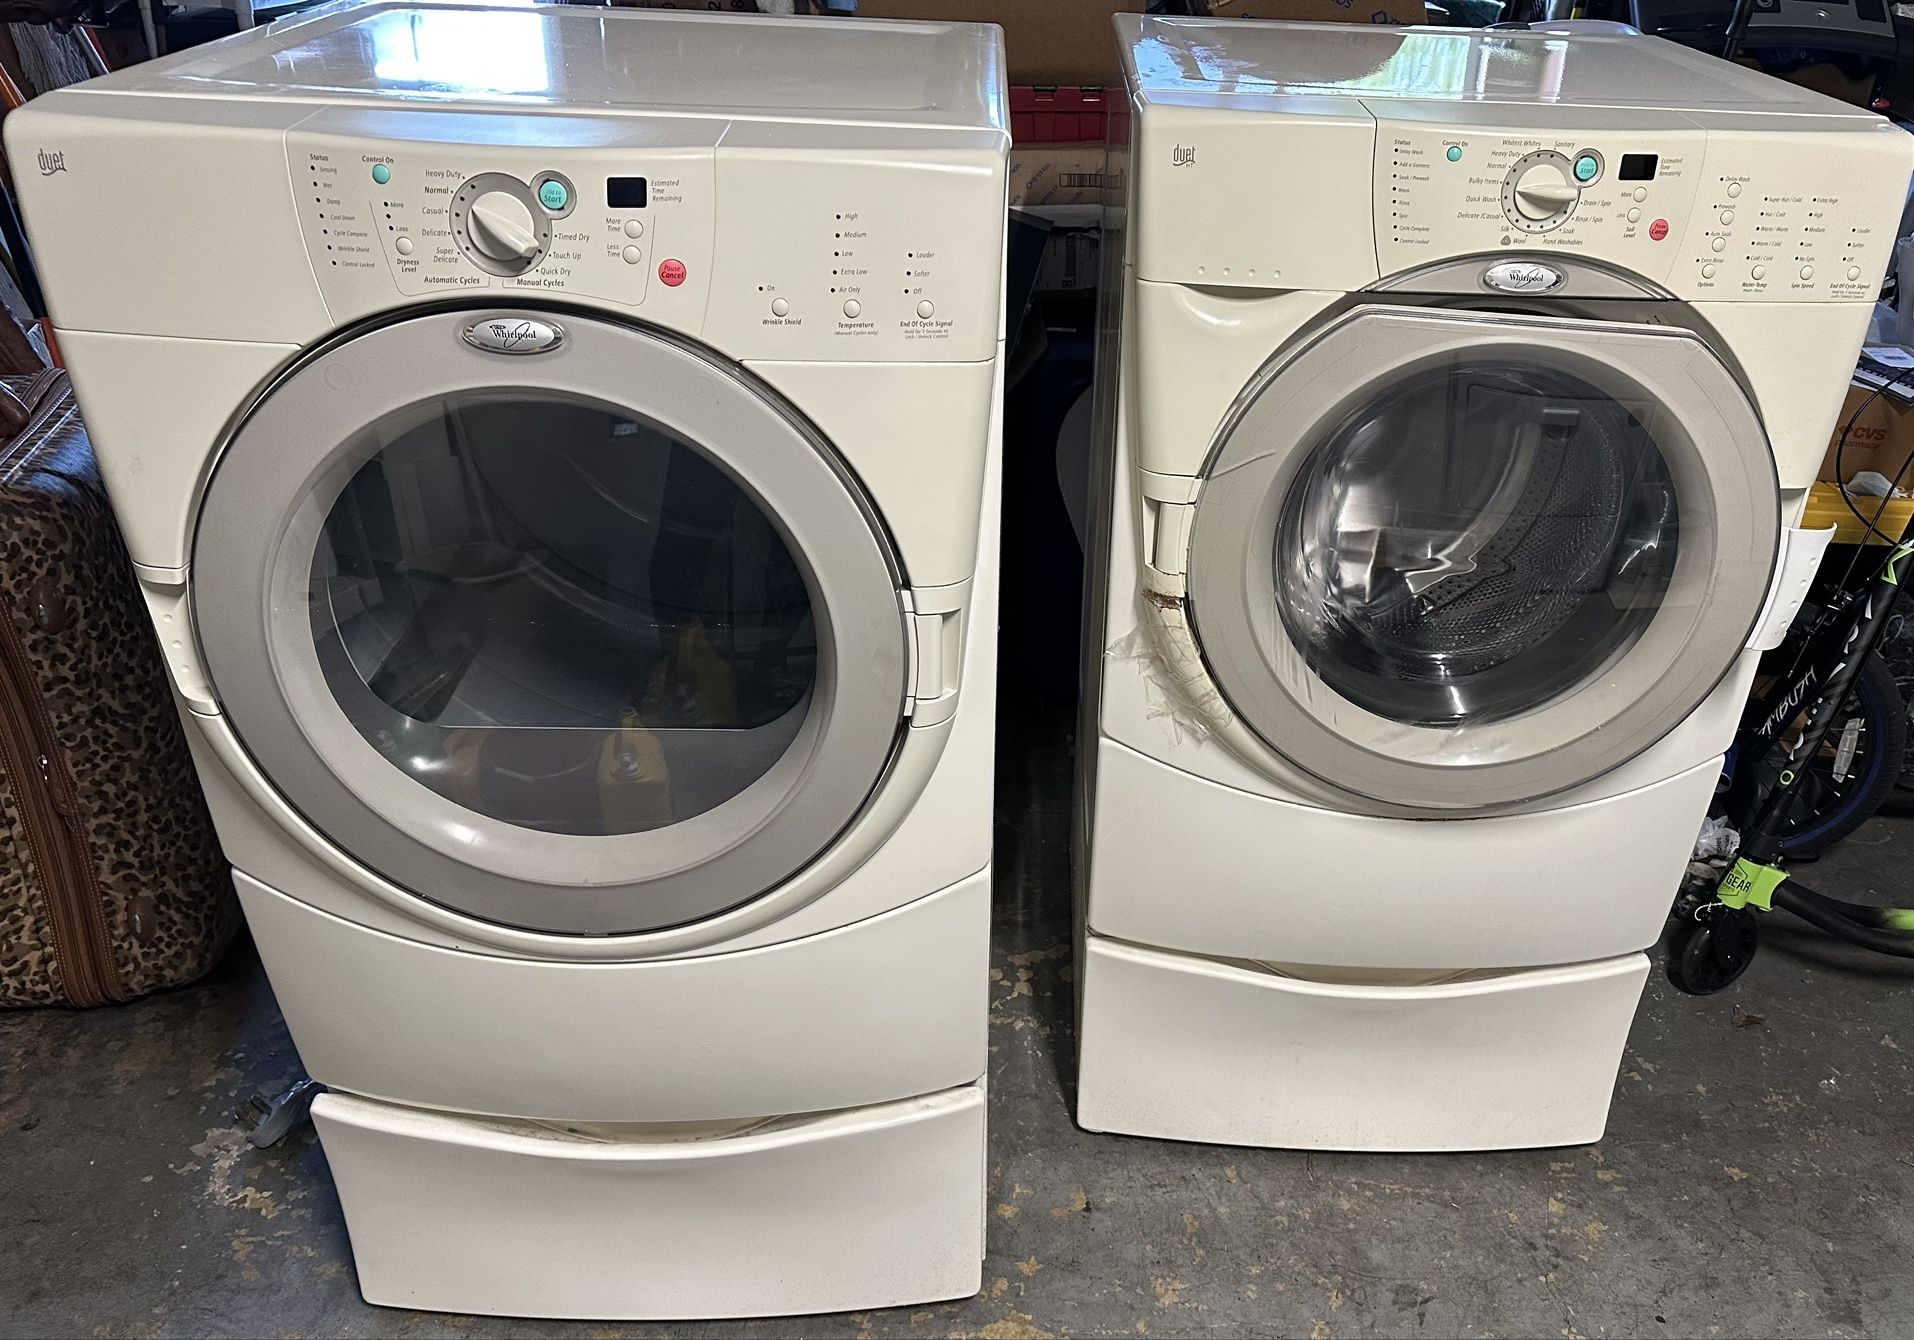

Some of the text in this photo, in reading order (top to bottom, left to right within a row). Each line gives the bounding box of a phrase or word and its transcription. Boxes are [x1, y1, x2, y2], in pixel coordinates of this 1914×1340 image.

[1523, 139, 1541, 147] Whites
[1554, 140, 1576, 149] Sanitary
[1173, 143, 1196, 163] duet
[37, 147, 66, 174] duet
[362, 155, 394, 164] Control On
[425, 169, 461, 179] Heavy Duty
[651, 179, 680, 187] Estimated
[1468, 177, 1485, 185] Bulky
[424, 186, 449, 194] Normal
[544, 195, 563, 203] Start
[652, 195, 682, 203] Remaining
[1465, 195, 1481, 203] Quick
[1457, 211, 1480, 219] Delicate
[558, 232, 591, 242] Timed Dry
[436, 246, 454, 255] Super
[916, 251, 935, 259] Louder
[433, 255, 458, 263] Delicate
[552, 252, 582, 260] Touch Up
[396, 258, 420, 267] Dryness
[540, 267, 571, 277] Quick Dry
[661, 271, 684, 279] Cancel
[423, 276, 480, 285] Automatic Cycles
[516, 278, 565, 288] Manual Cycles
[1509, 273, 1544, 284] Whirlpool
[848, 286, 861, 294] Only
[919, 320, 934, 328] Cycle
[935, 320, 953, 328] Signal
[492, 330, 537, 341] Whirlpool
[1853, 426, 1887, 441] CVS
[1757, 664, 1817, 735] AMBUSH
[1726, 873, 1752, 893] GEAR
